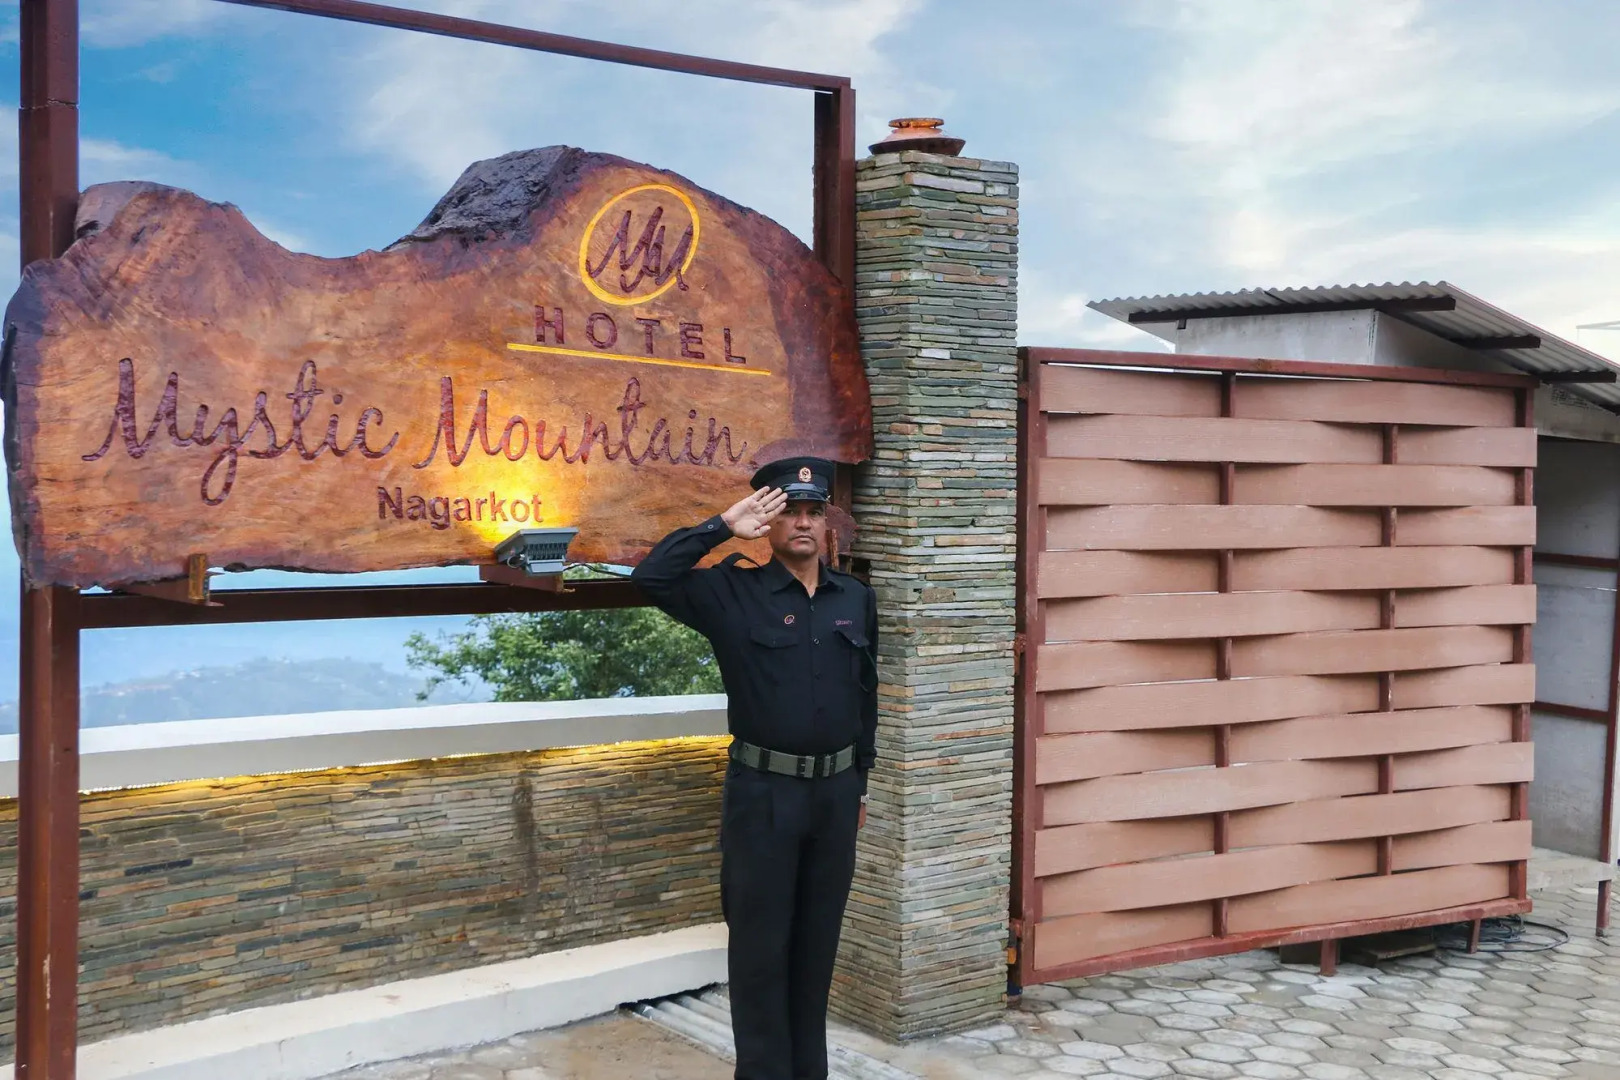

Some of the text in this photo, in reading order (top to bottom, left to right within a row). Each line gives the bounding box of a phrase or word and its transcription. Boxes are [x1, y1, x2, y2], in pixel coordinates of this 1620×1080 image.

[534, 304, 747, 364] HOTEL
[81, 357, 748, 506] Mystic Mountain
[377, 486, 544, 531] Nagarkot
